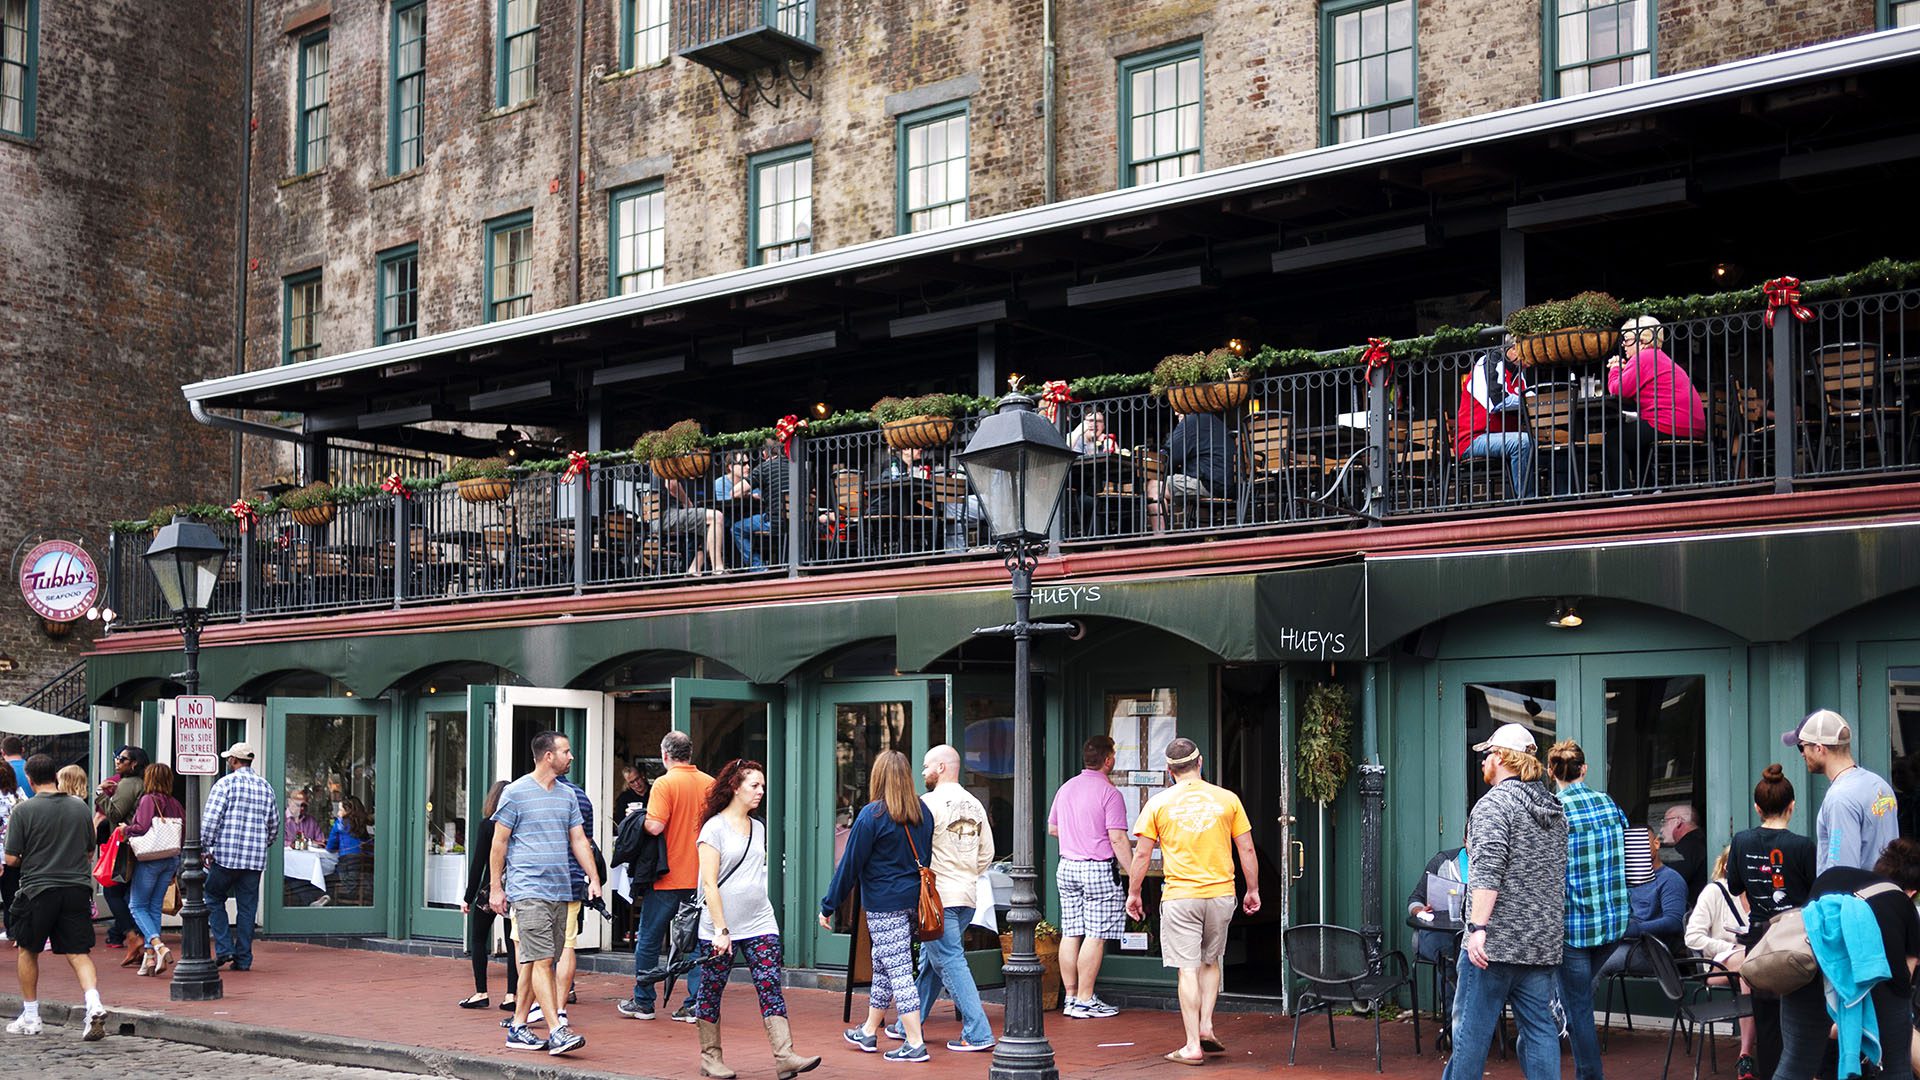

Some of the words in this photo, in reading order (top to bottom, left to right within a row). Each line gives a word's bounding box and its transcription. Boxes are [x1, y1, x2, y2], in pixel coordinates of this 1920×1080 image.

[45, 591, 81, 601] SEAFOOD
[1031, 586, 1101, 610] HUEY'S
[26, 592, 54, 617] RIVER
[59, 594, 93, 618] STREET
[1281, 627, 1345, 661] HUEY'S
[188, 703, 203, 715] NO
[179, 717, 213, 730] PARKING
[180, 733, 195, 742] THIS
[197, 733, 212, 742] SIDE
[180, 744, 188, 753] OF
[191, 744, 213, 753] STREET
[1134, 773, 1157, 784] dinner
